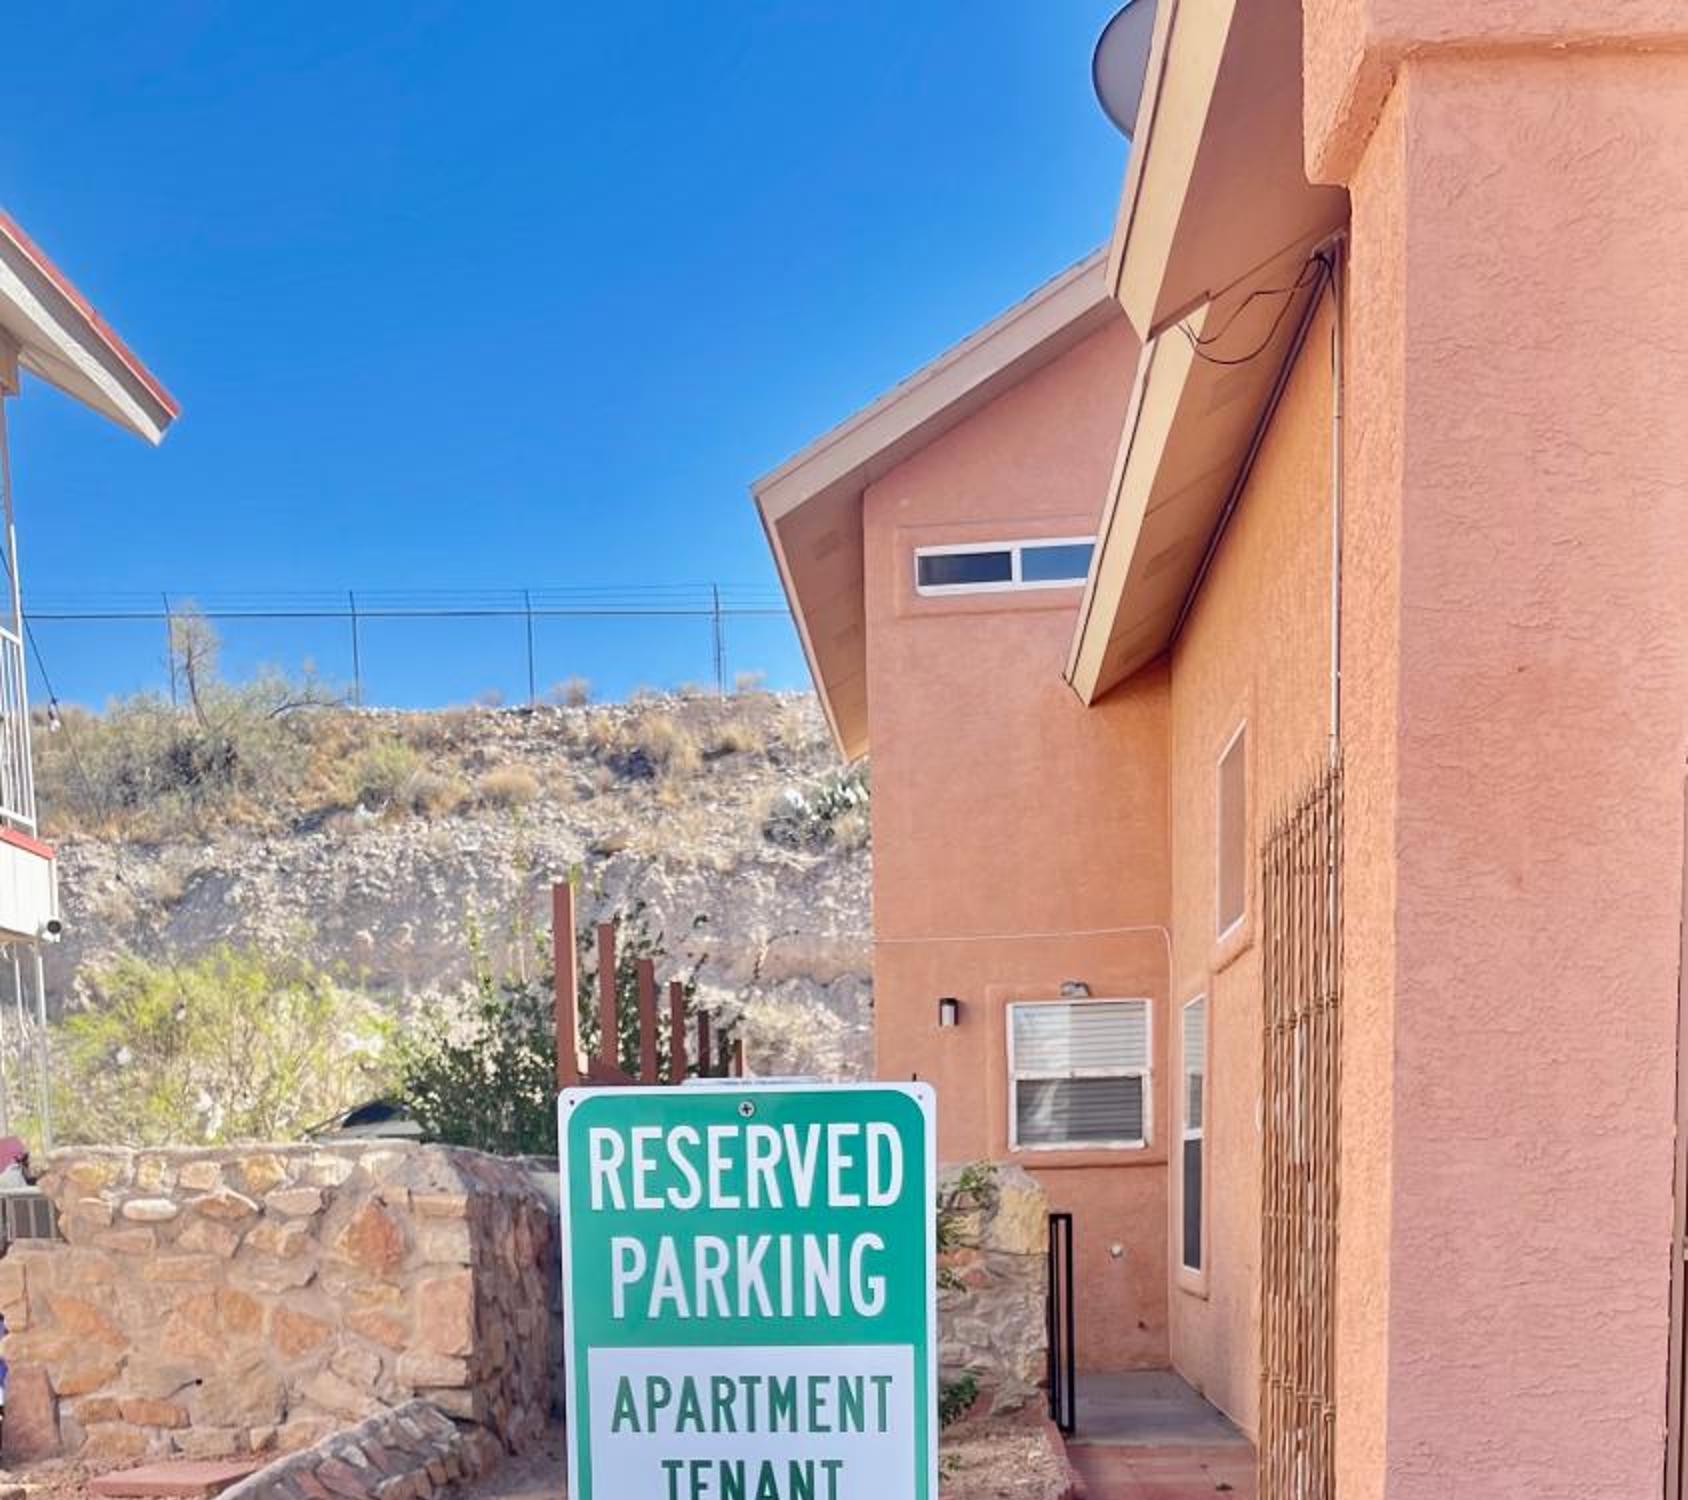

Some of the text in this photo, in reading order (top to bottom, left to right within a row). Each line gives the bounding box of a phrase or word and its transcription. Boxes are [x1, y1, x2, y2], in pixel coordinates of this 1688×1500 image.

[587, 1121, 904, 1211] RESERVED
[610, 1232, 886, 1319] PARKING
[611, 1375, 893, 1433] APARTMENT
